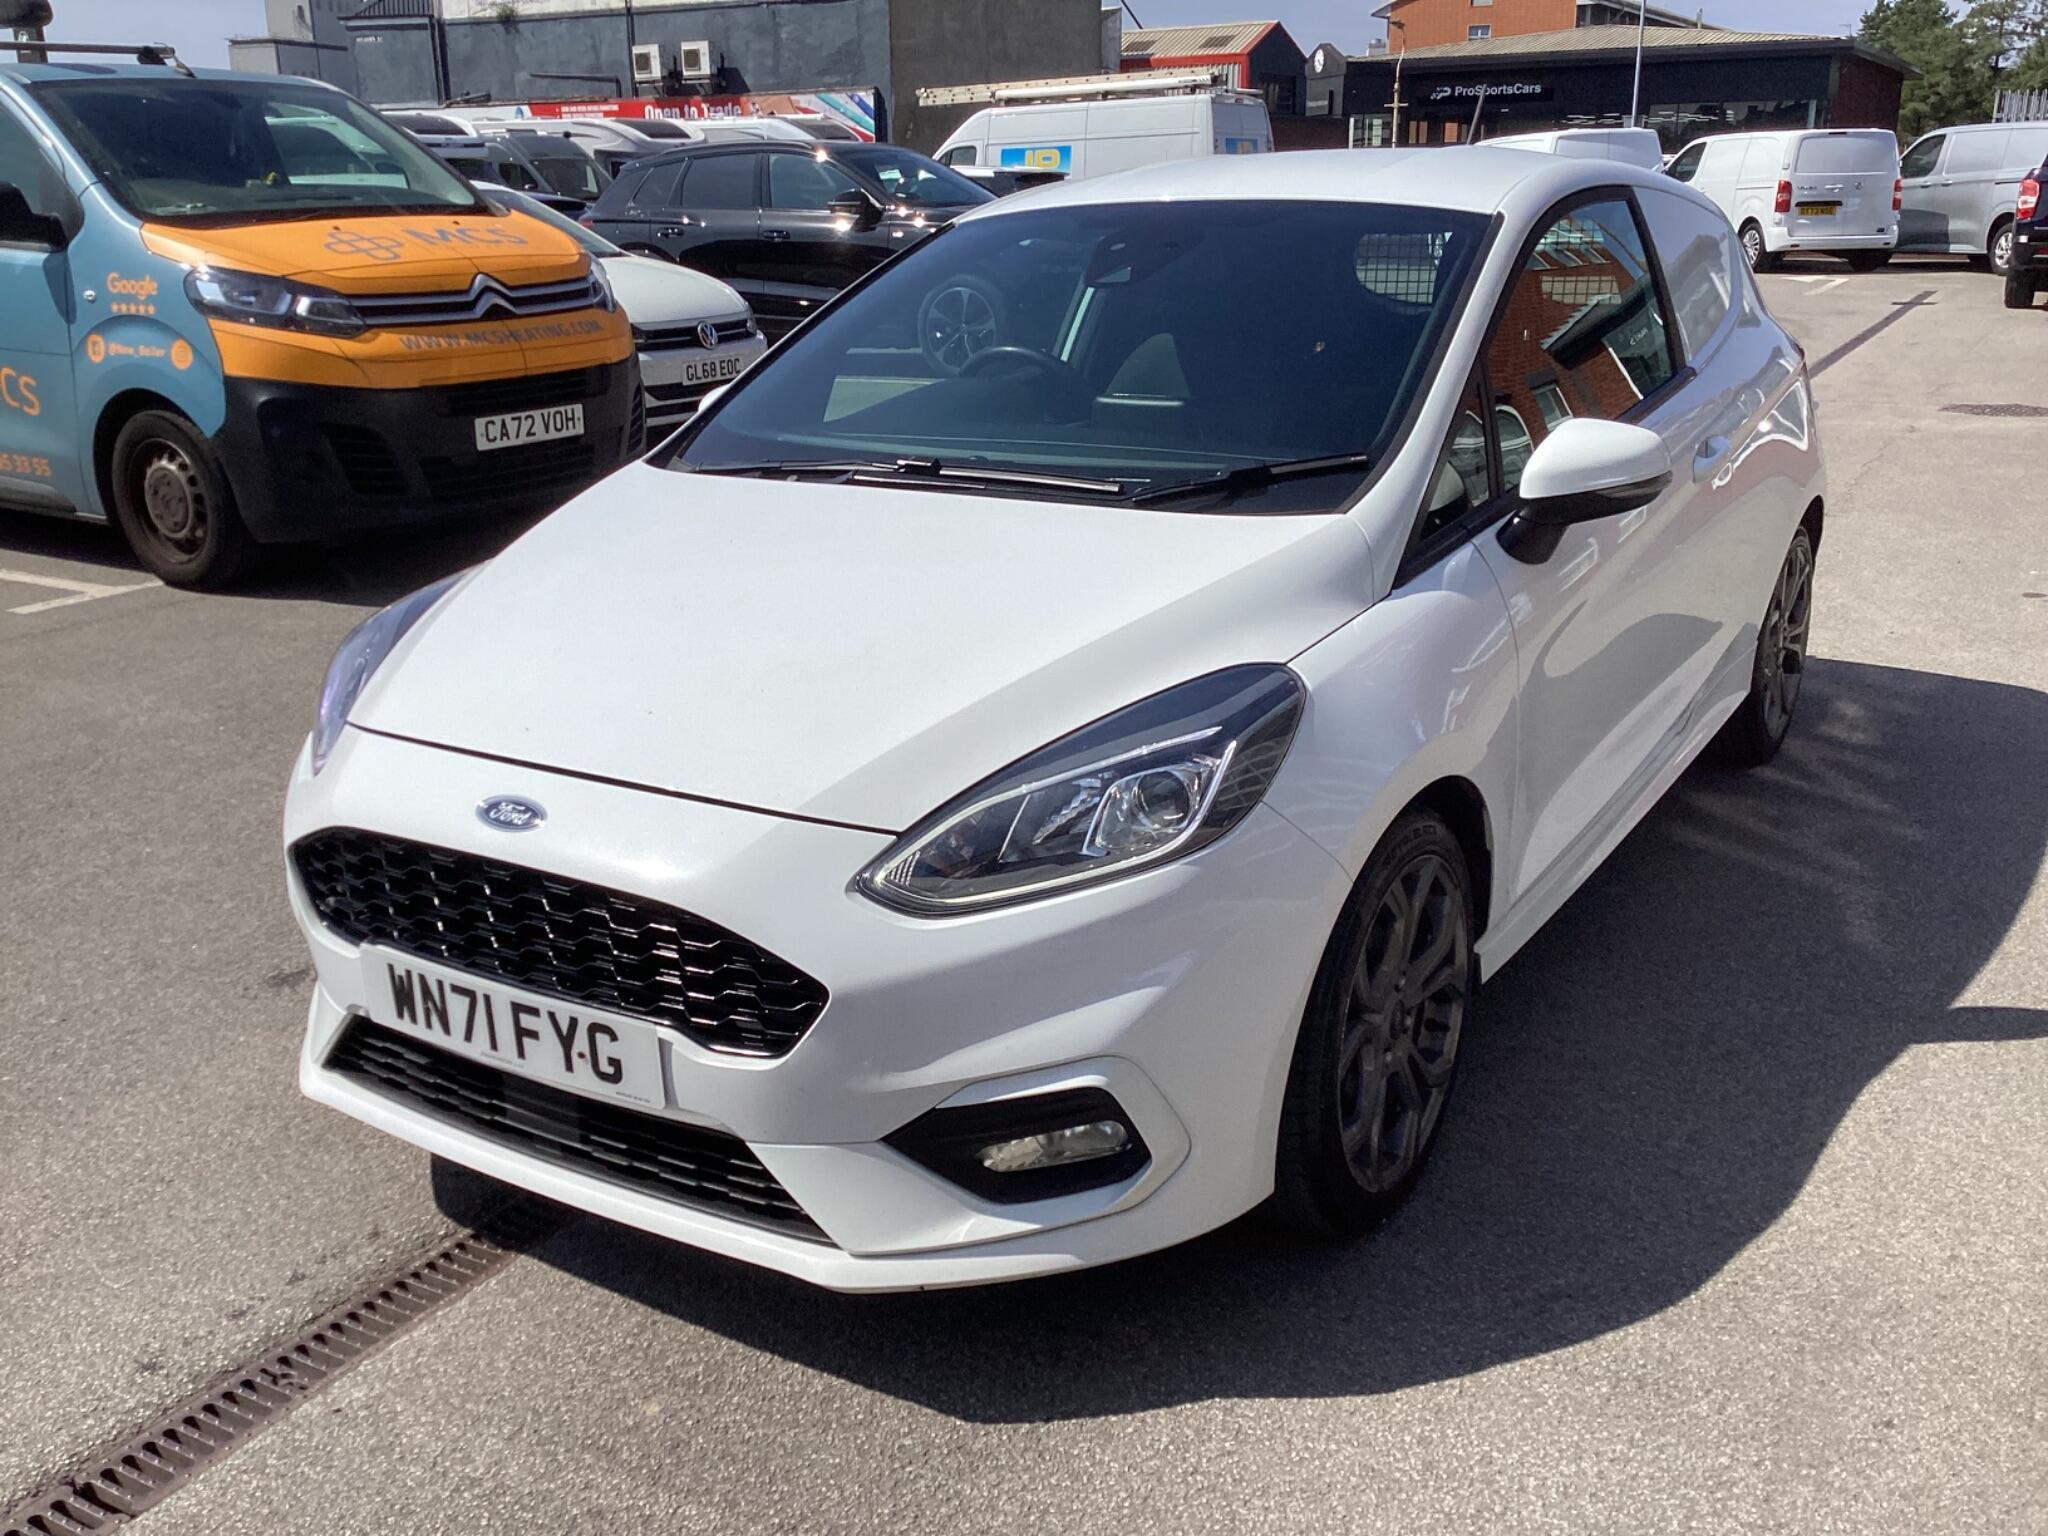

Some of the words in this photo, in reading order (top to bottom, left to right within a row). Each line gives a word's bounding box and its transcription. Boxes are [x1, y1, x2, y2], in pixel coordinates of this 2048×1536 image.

[644, 104, 680, 120] Open
[684, 104, 698, 120] to
[401, 227, 529, 245] MCS
[107, 272, 157, 300] Google
[400, 319, 604, 351] WWW.MCSHEATING.COM
[686, 361, 717, 382] GL68
[719, 358, 741, 376] EOC
[0, 367, 40, 416] CS
[484, 414, 537, 443] CA72
[541, 407, 577, 434] VOH
[489, 801, 532, 825] Ford
[386, 962, 499, 1053] WN71
[509, 1000, 624, 1085] FYG
